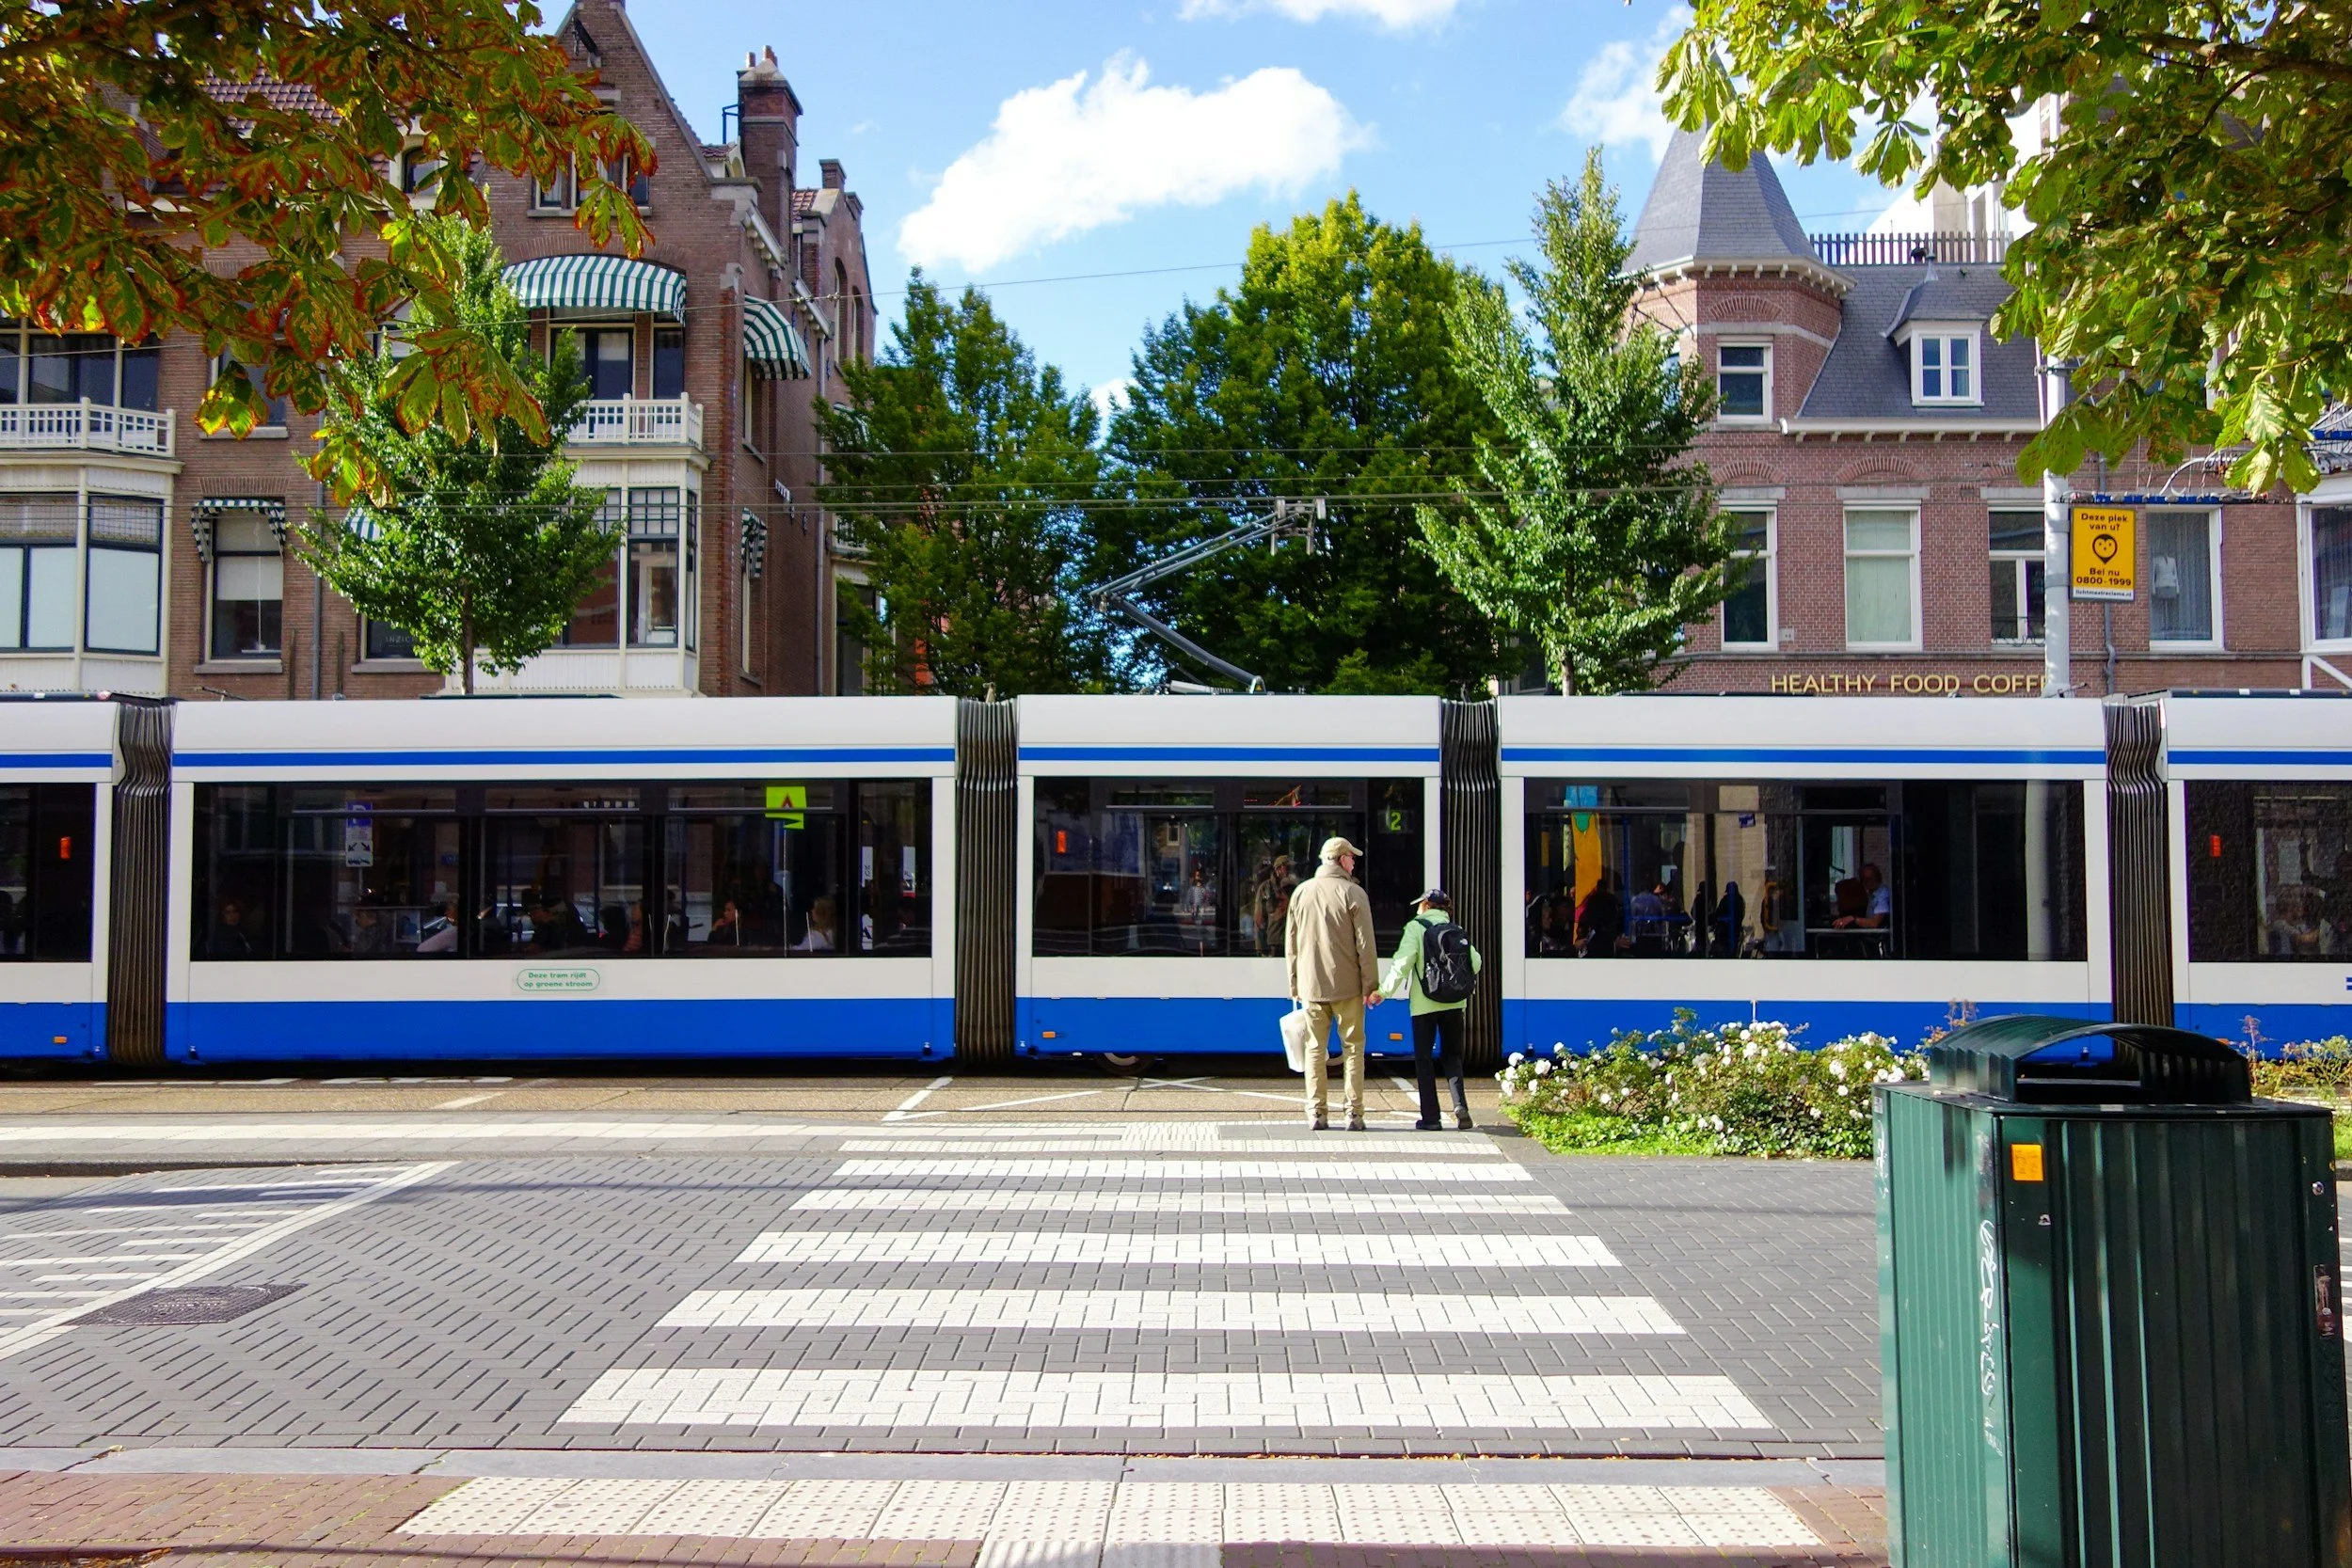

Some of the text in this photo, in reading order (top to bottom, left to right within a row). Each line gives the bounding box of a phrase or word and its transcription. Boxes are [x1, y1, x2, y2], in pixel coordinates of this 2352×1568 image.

[2108, 514, 2128, 523] plek
[1772, 673, 1877, 693] HEALTHY
[1890, 673, 1961, 693] FOOD
[1391, 811, 1402, 832] 2
